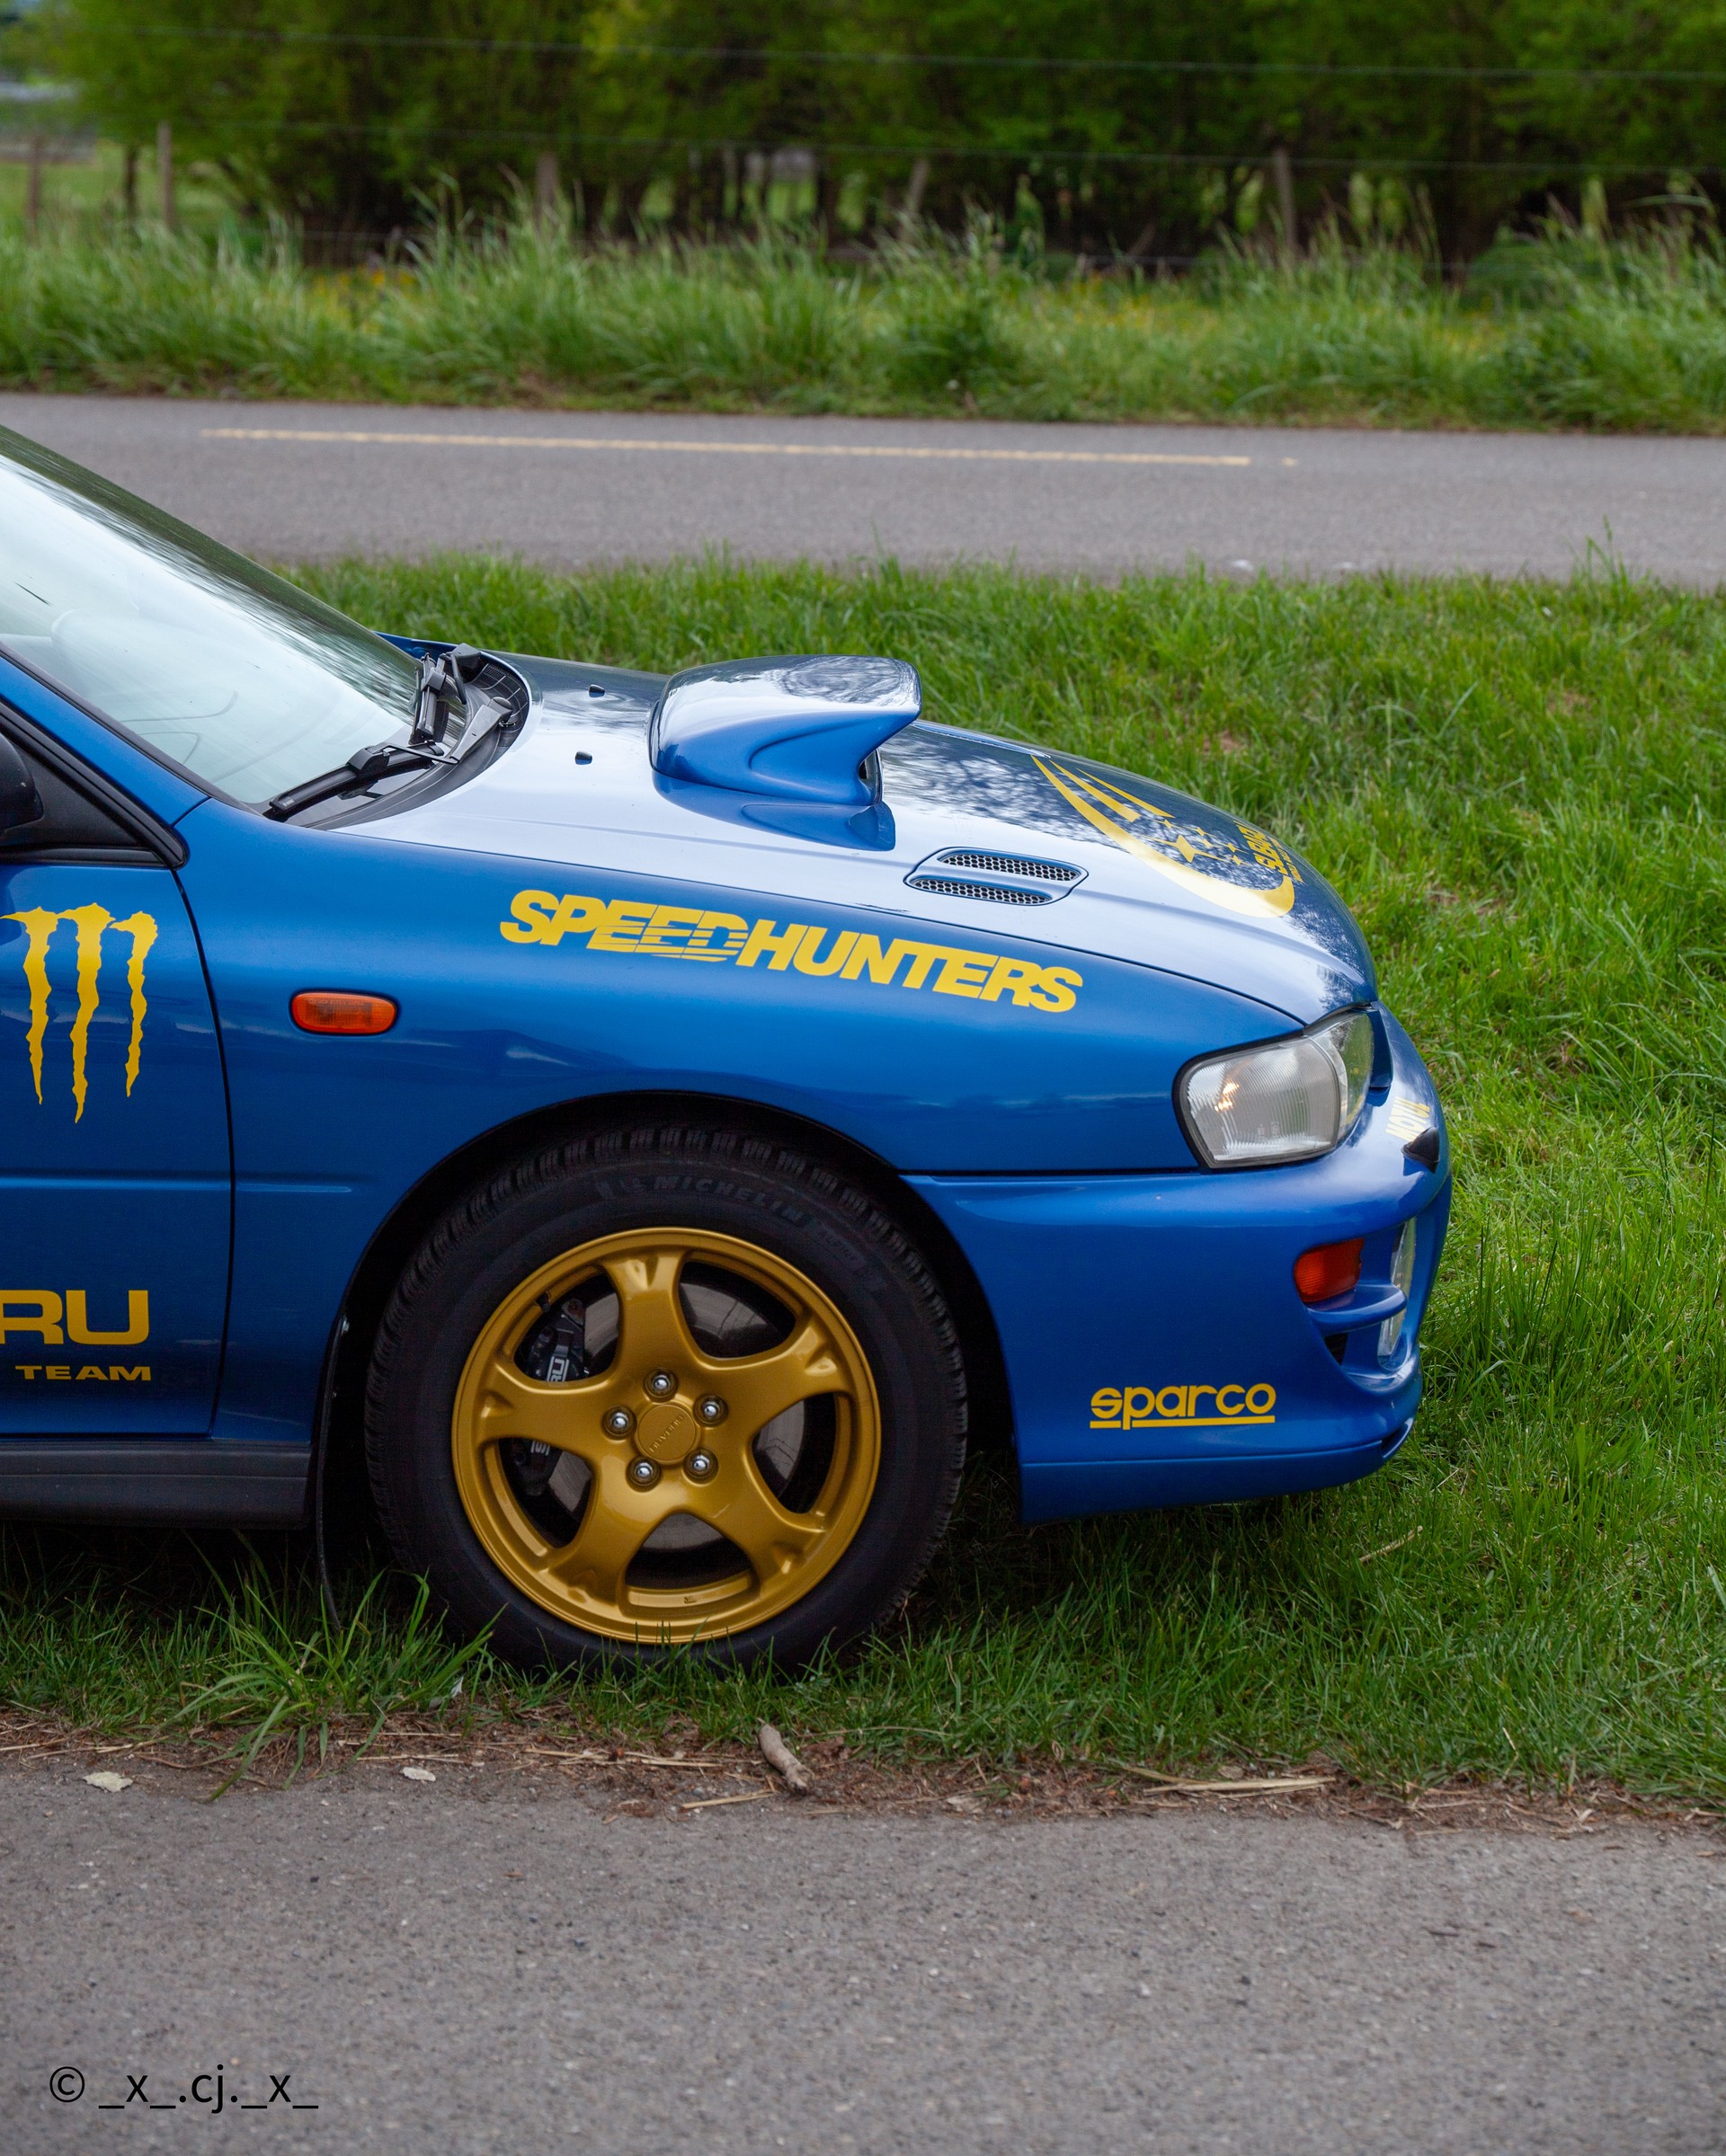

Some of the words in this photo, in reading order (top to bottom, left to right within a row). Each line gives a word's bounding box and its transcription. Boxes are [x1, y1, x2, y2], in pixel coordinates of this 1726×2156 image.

[500, 890, 1083, 1014] SPEEDHUNTERS
[654, 1176, 805, 1223] MICHELIN
[14, 1365, 152, 1381] TEAM
[1090, 1382, 1277, 1430] sparco
